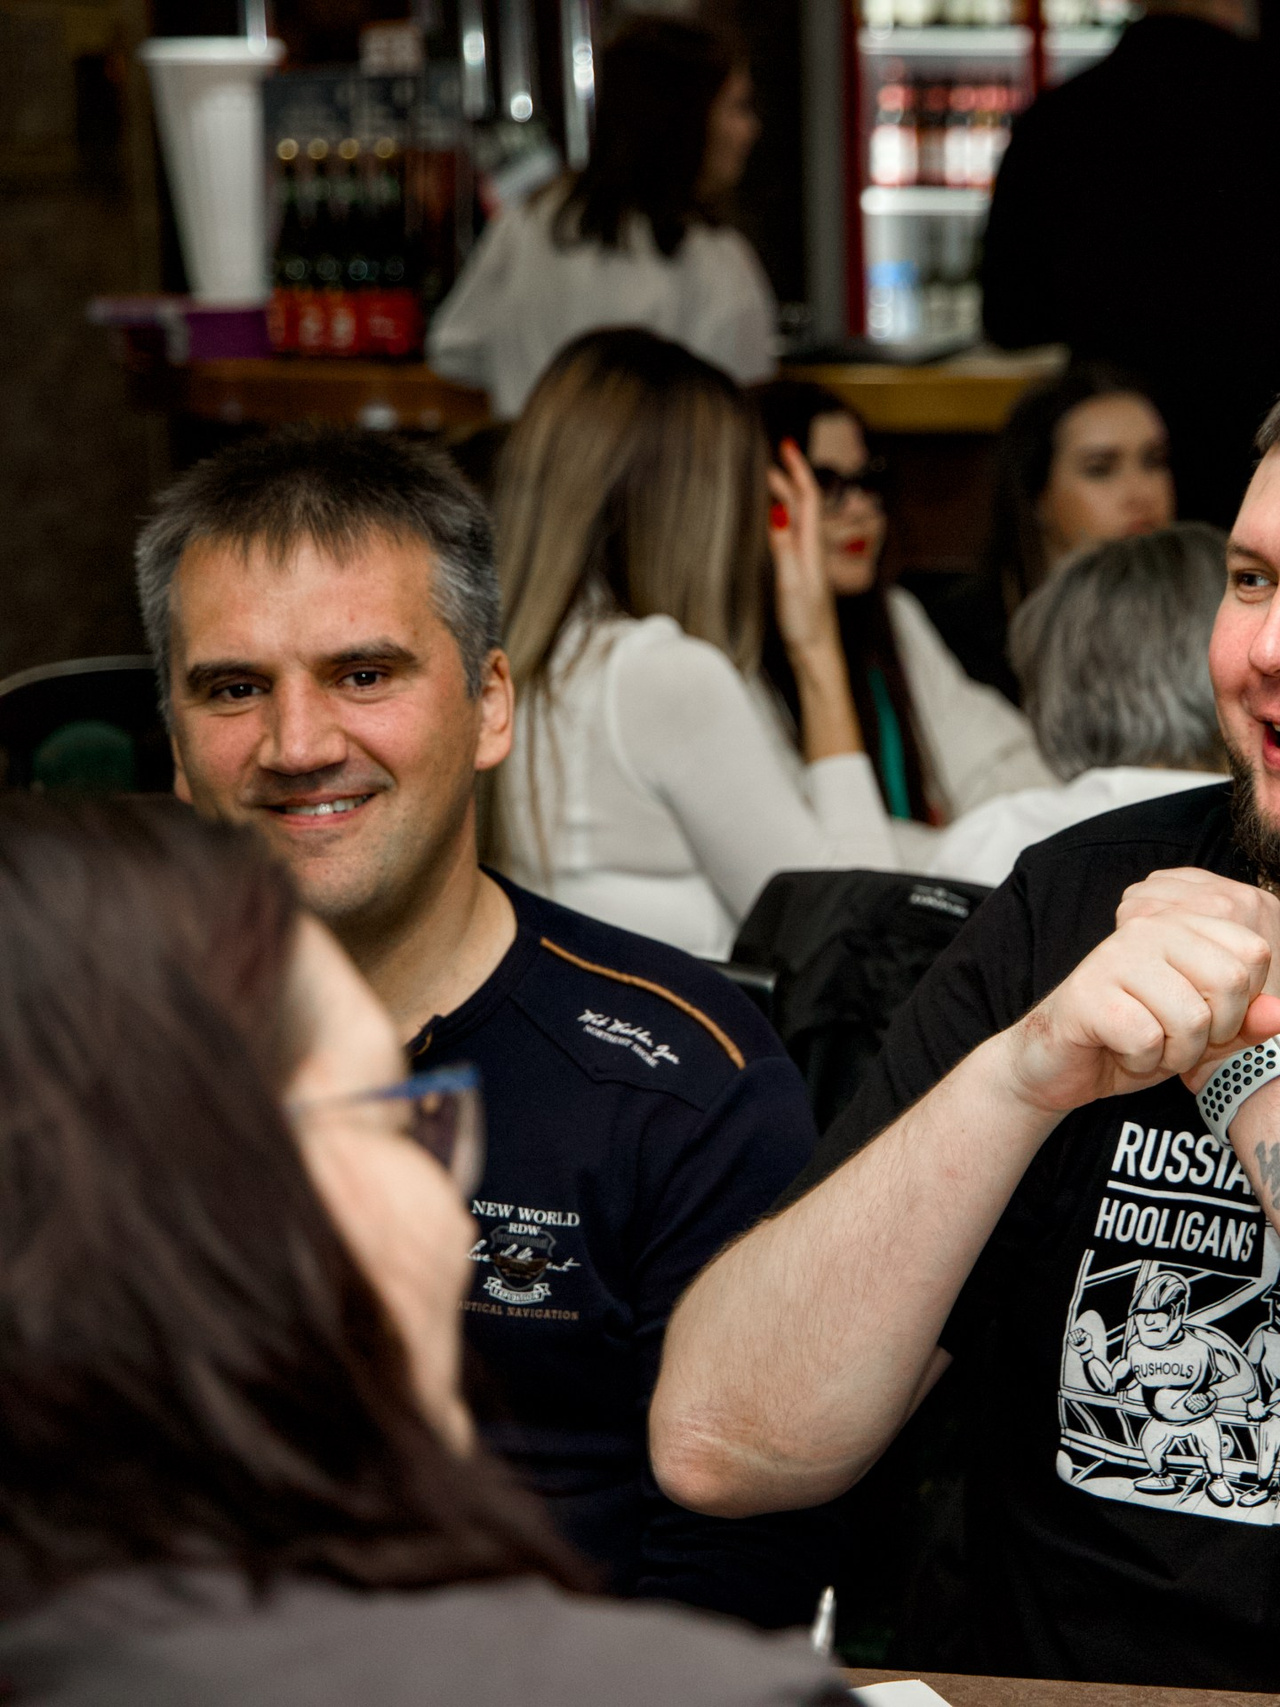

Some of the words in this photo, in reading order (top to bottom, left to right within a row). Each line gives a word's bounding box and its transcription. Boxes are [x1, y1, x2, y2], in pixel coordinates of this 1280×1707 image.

[1111, 1121, 1255, 1196] RUSSIA
[471, 1200, 515, 1218] NEW
[518, 1206, 580, 1227] WORLD
[508, 1222, 541, 1236] RDW
[1094, 1197, 1257, 1262] HOOLIGANS
[461, 1301, 503, 1316] UTICAL
[507, 1306, 579, 1320] NAVIGATION
[1133, 1362, 1194, 1379] RUSHOOLS
